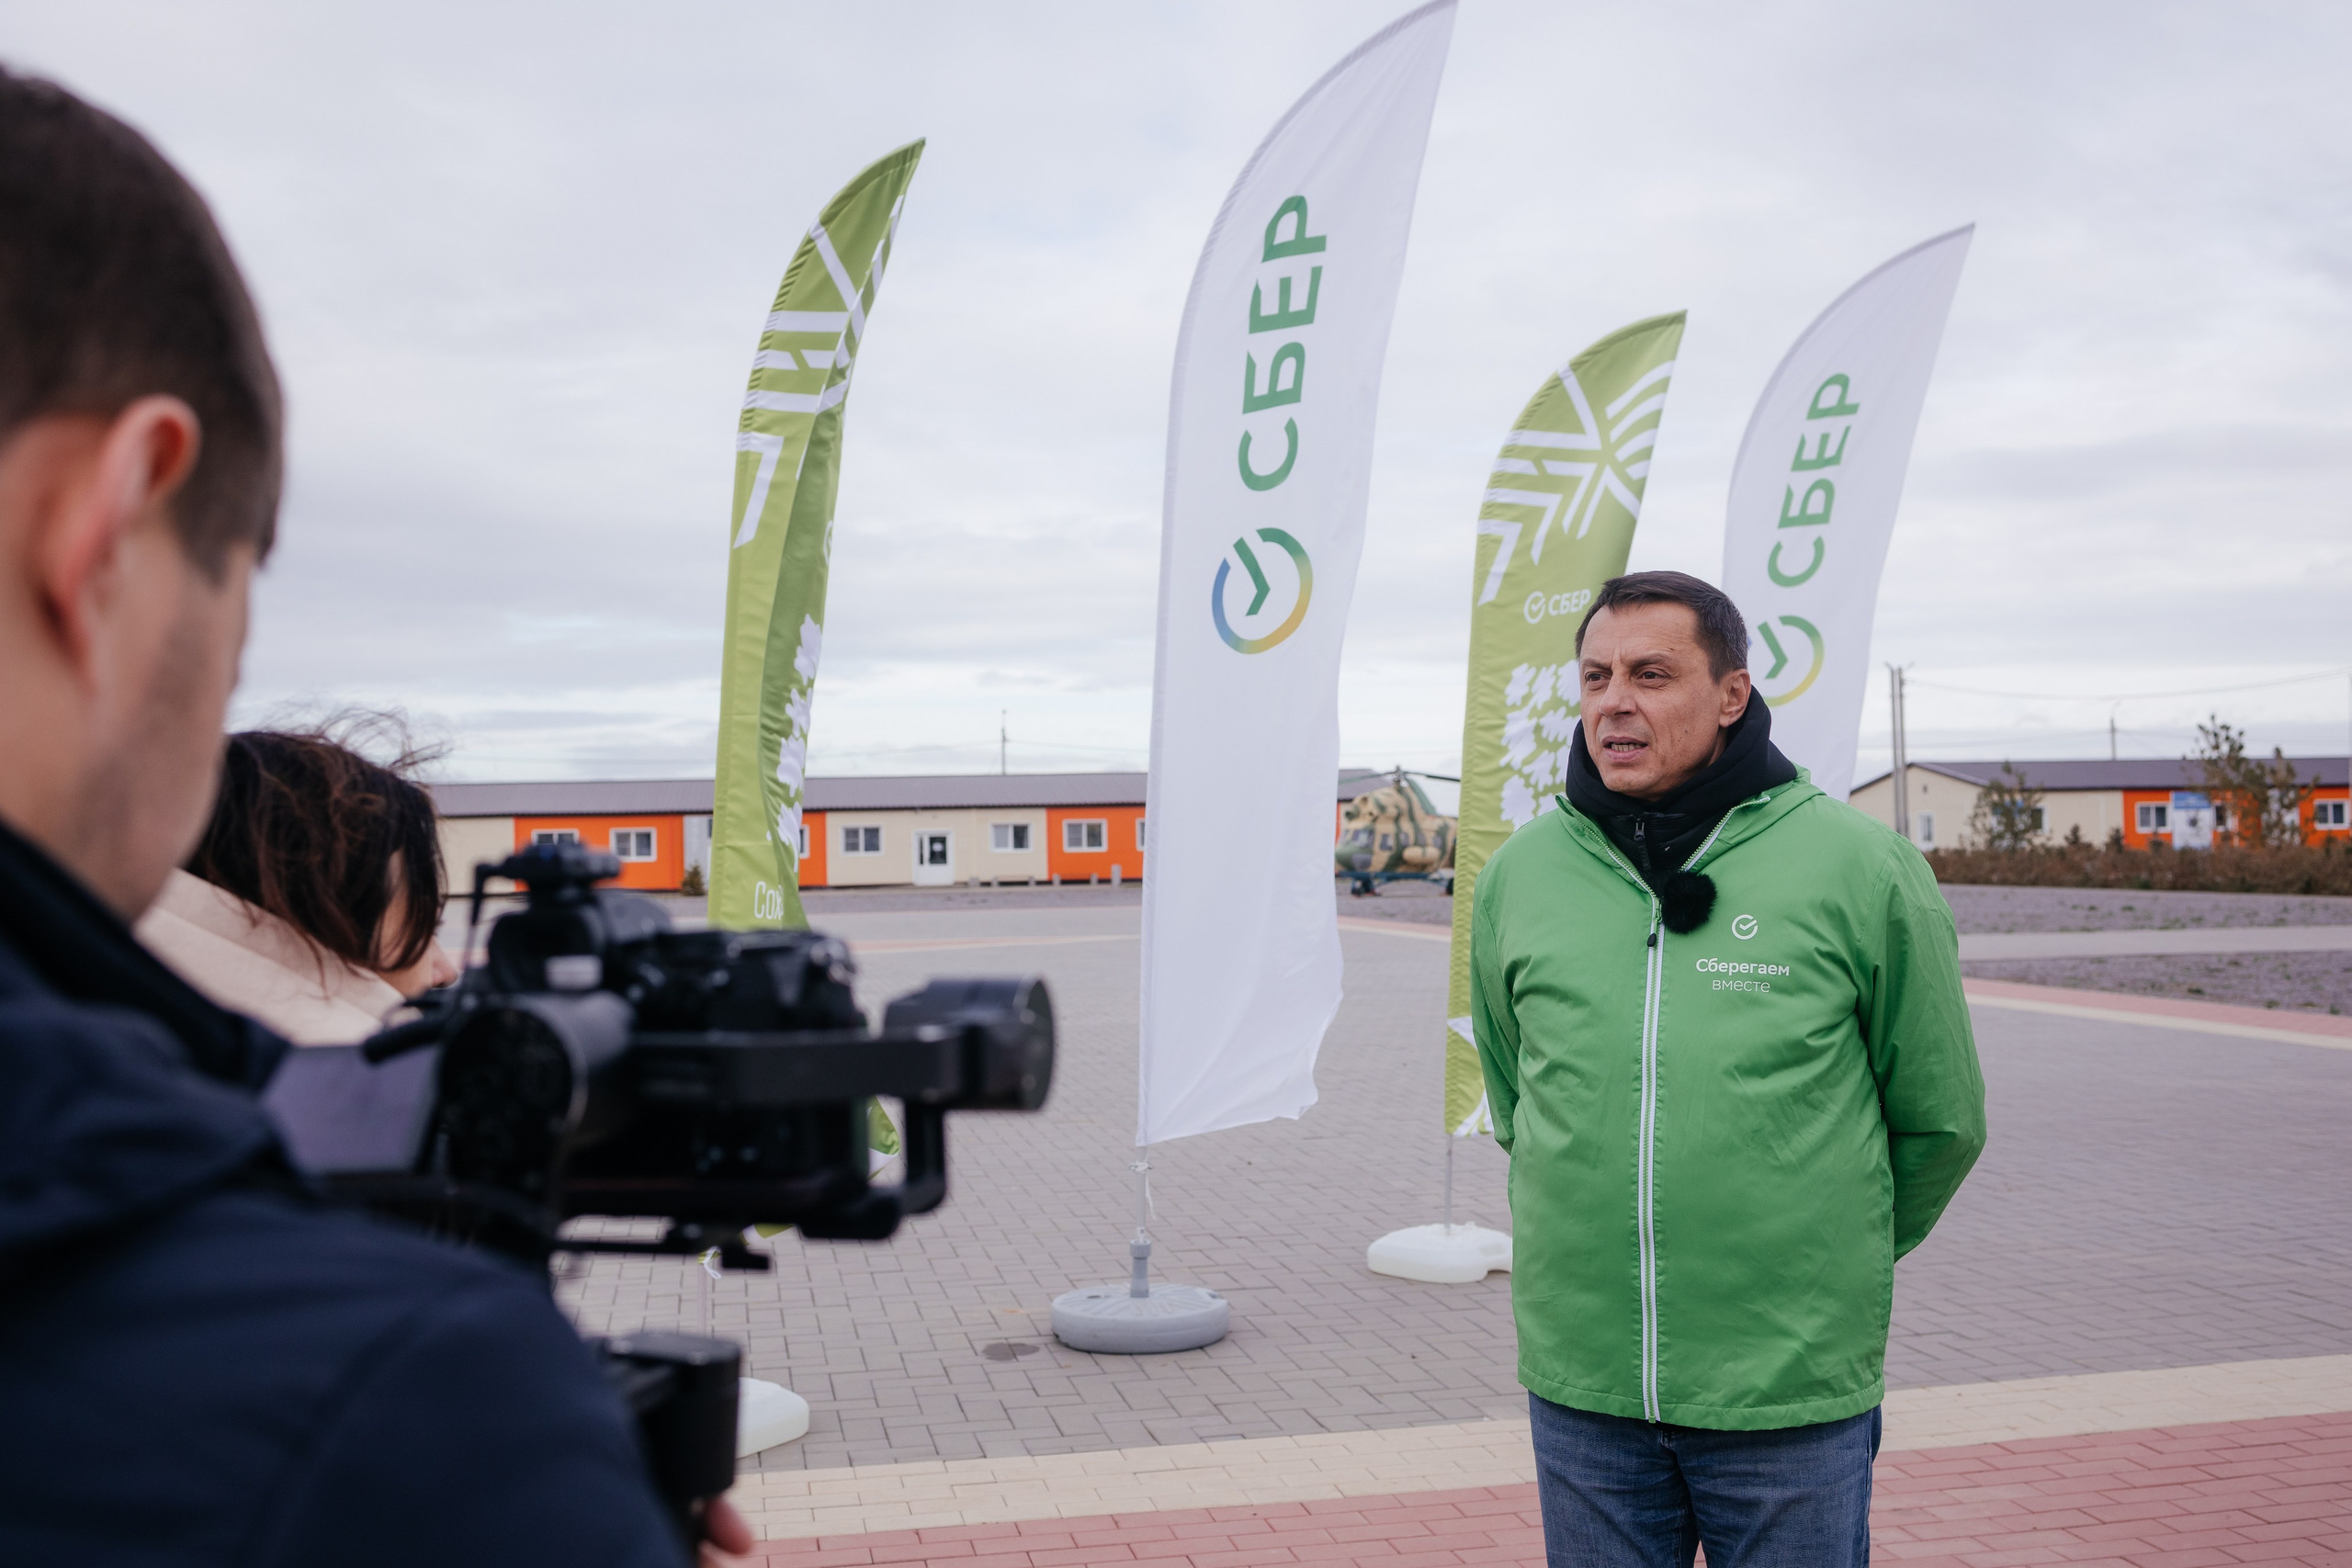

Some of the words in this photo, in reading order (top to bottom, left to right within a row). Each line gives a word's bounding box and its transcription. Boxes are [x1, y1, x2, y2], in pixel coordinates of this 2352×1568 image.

[1238, 194, 1328, 492] СБЕР
[1767, 372, 1860, 589] СБЕР
[1547, 588, 1592, 616] СБЕР
[753, 880, 785, 920] Сох
[1695, 957, 1791, 976] Сберегаем
[1712, 979, 1770, 993] вместе
